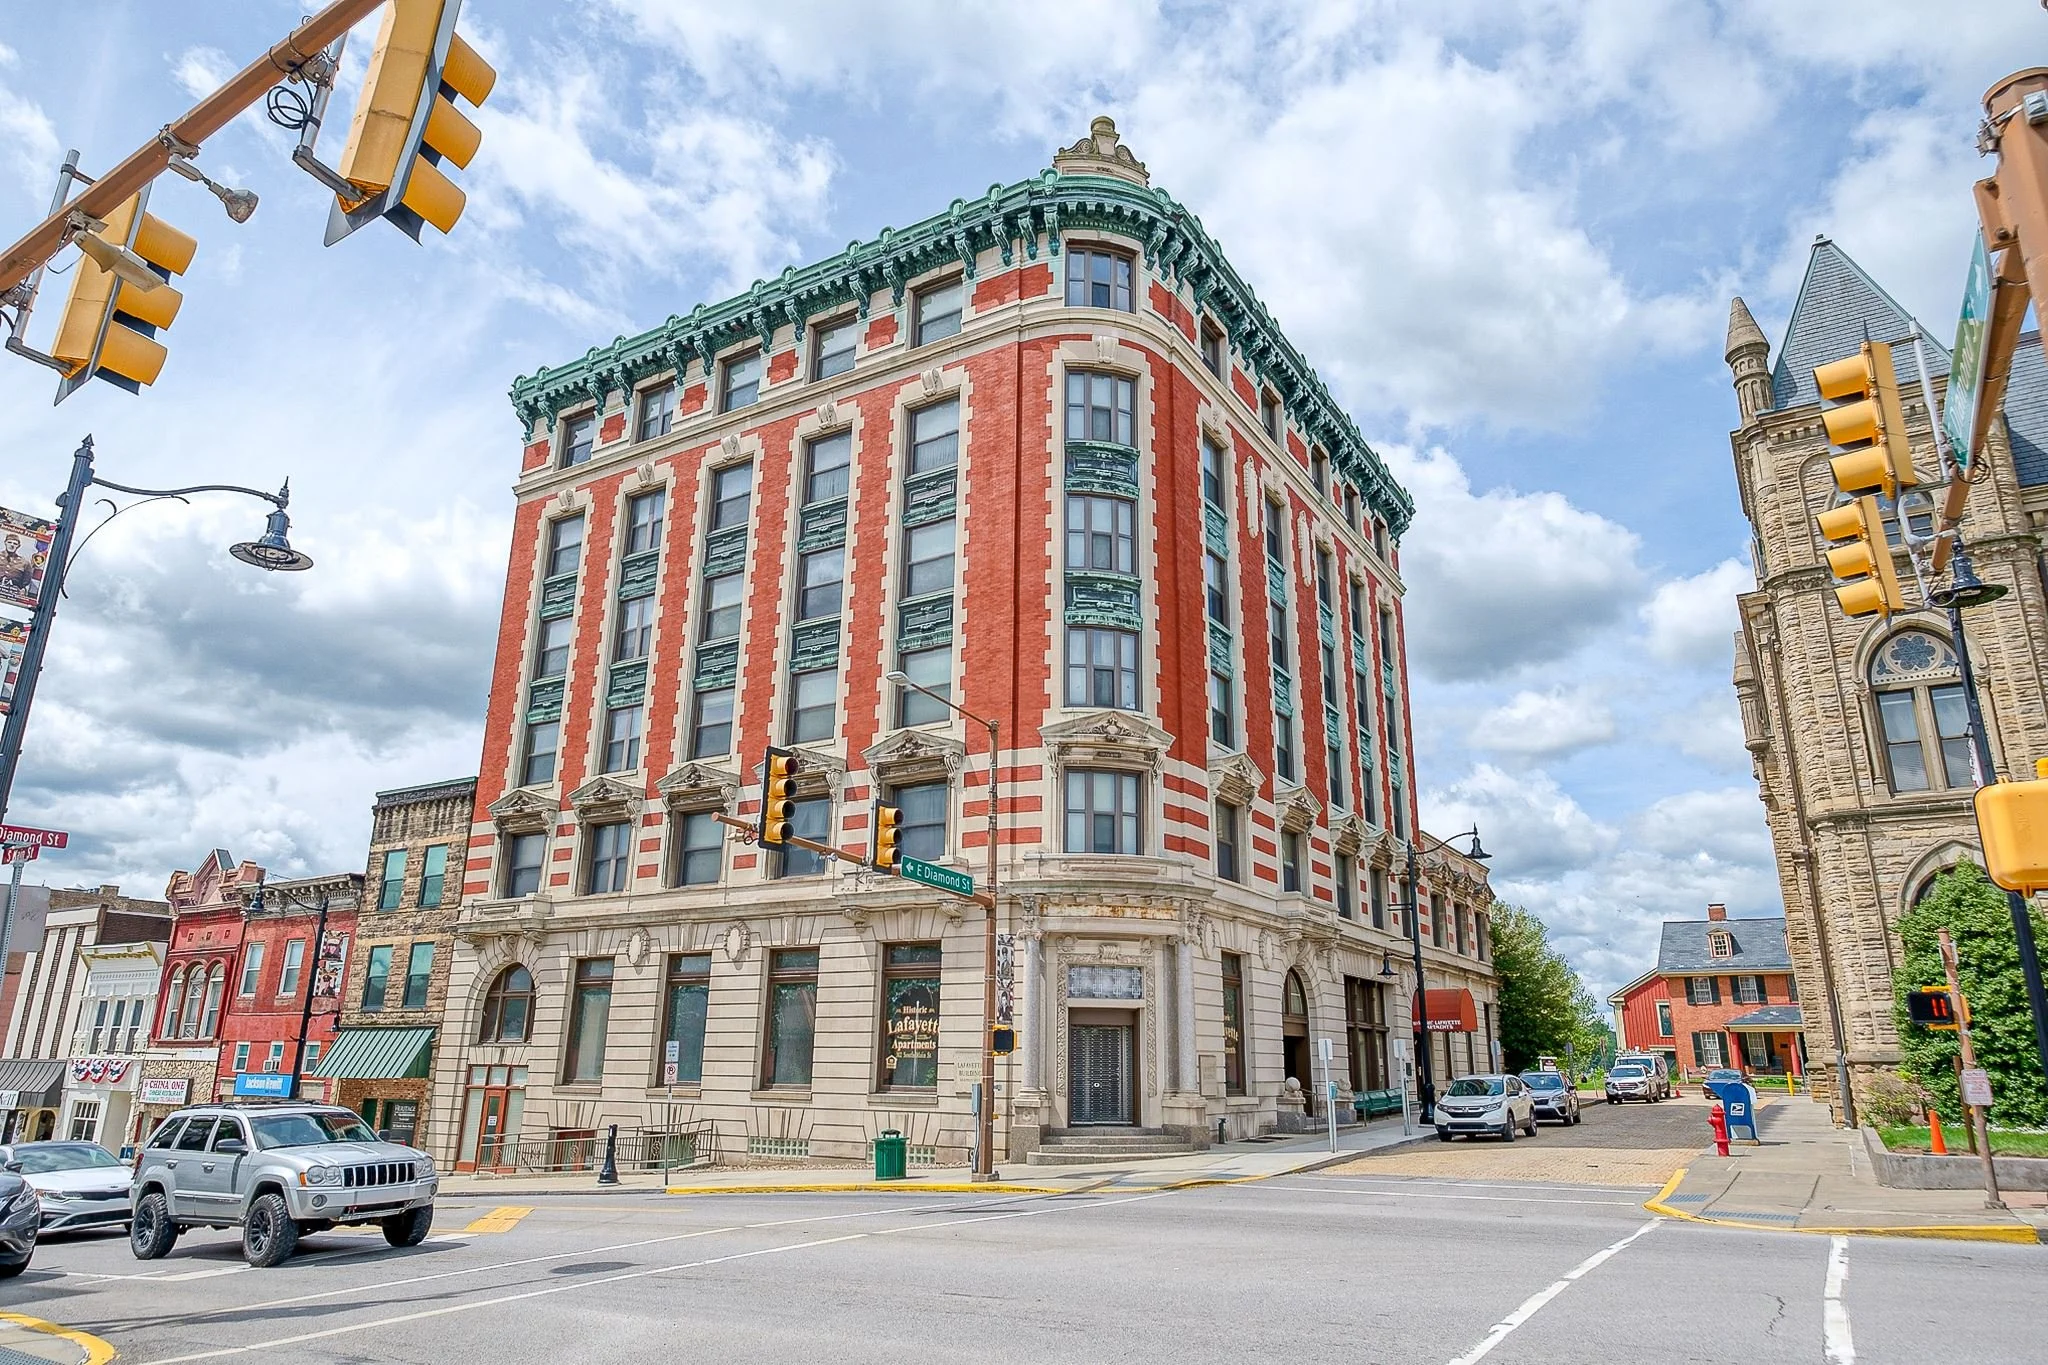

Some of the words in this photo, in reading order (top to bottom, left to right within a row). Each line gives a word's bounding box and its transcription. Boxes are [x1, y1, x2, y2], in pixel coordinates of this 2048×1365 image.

[47, 832, 60, 846] St
[6, 849, 12, 863] S
[26, 846, 35, 860] St
[916, 864, 922, 877] E
[924, 866, 960, 888] Diamond
[961, 878, 970, 891] St
[902, 1005, 928, 1014] Historic
[1932, 998, 1949, 1017] 11
[891, 1039, 937, 1052] Apartments
[957, 1062, 982, 1070] LAFAYETT
[149, 1080, 169, 1090] CHINA
[171, 1082, 186, 1090] ONE
